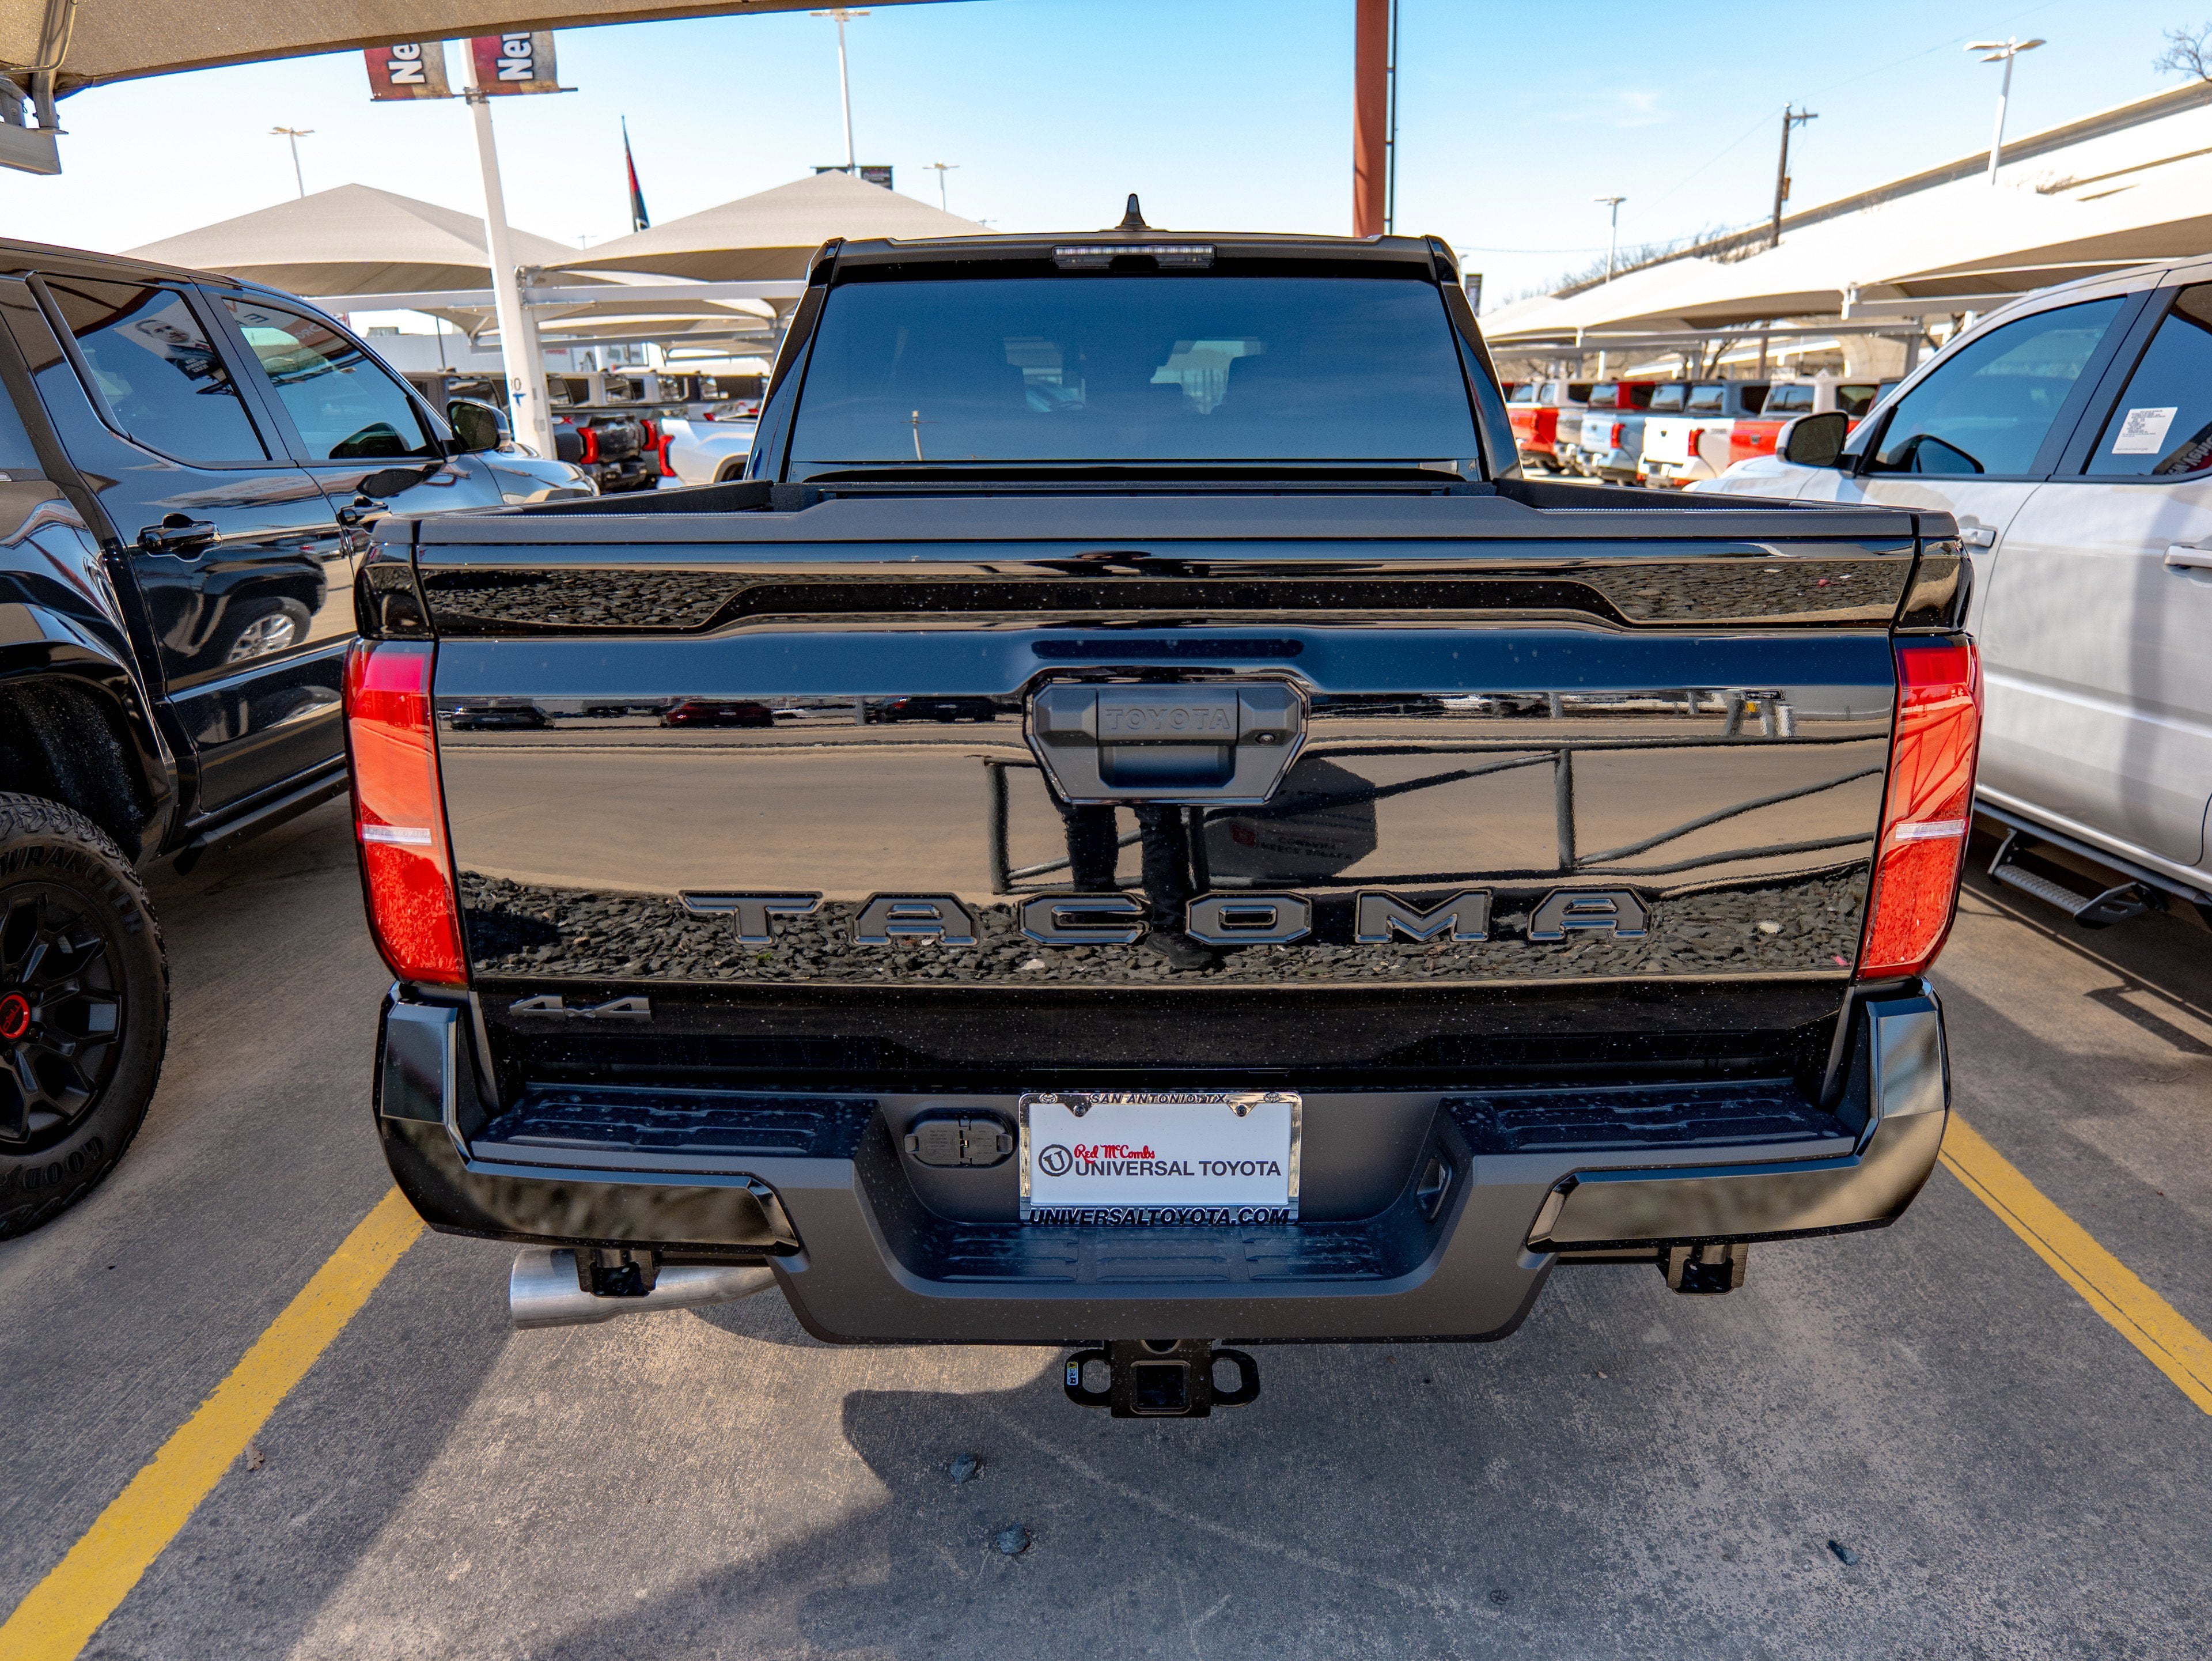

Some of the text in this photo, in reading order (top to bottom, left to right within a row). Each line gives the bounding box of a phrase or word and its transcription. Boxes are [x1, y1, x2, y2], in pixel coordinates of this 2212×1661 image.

[1105, 707, 1230, 730] TOYOTA
[678, 886, 1654, 948] TACOMA
[1089, 1094, 1230, 1104] SAN ANTONIO, TX.
[1074, 1144, 1156, 1164] Red McCombs
[1075, 1160, 1282, 1176] UNIVERSAL TOYOTA
[1028, 1207, 1291, 1225] UNIVERSALTOYOTA.COM
